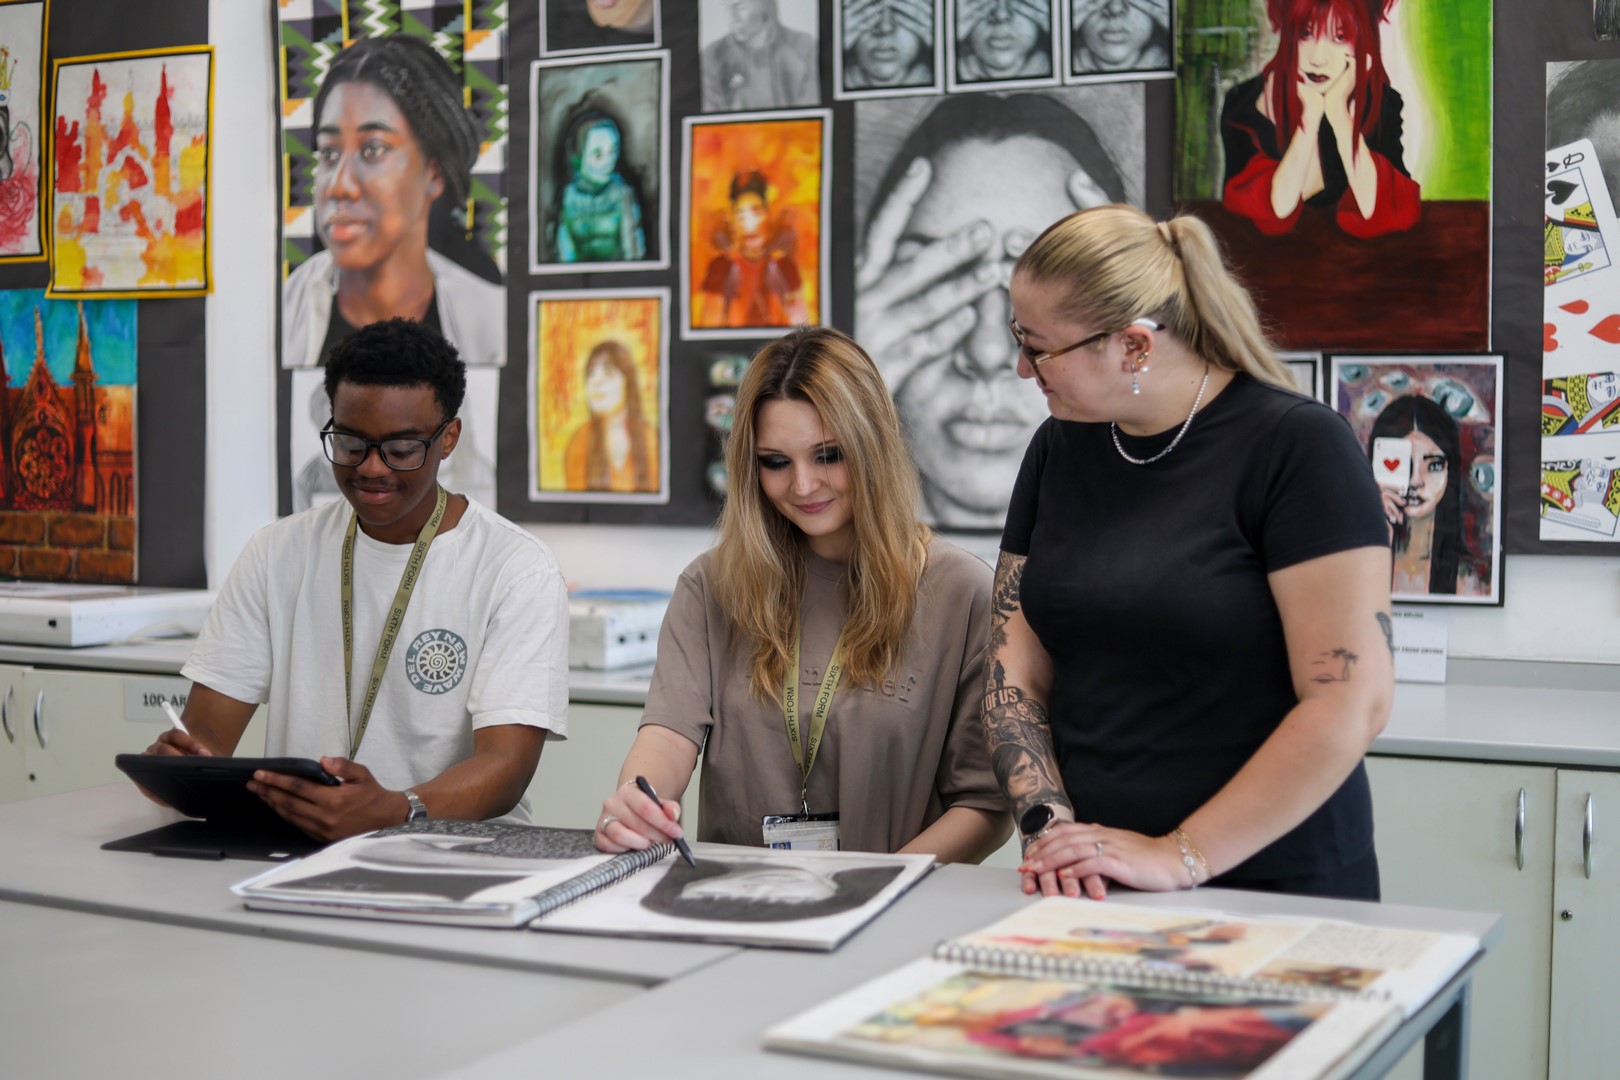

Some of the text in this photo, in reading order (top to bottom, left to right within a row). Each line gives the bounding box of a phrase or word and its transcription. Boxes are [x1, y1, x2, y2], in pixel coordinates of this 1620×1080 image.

[1563, 152, 1585, 169] Q
[430, 504, 444, 528] FORM
[344, 535, 352, 560] FORM
[403, 541, 427, 590] SIXTH FORM
[380, 607, 402, 660] SIXTH FORM
[407, 631, 466, 693] DEL REY NEW WAVE
[360, 676, 379, 729] SIXTH FORM
[786, 687, 798, 742] SIXTH FORM
[816, 665, 840, 718] SIXTH FORM
[998, 688, 1019, 705] US
[806, 737, 818, 763] SIXTH
